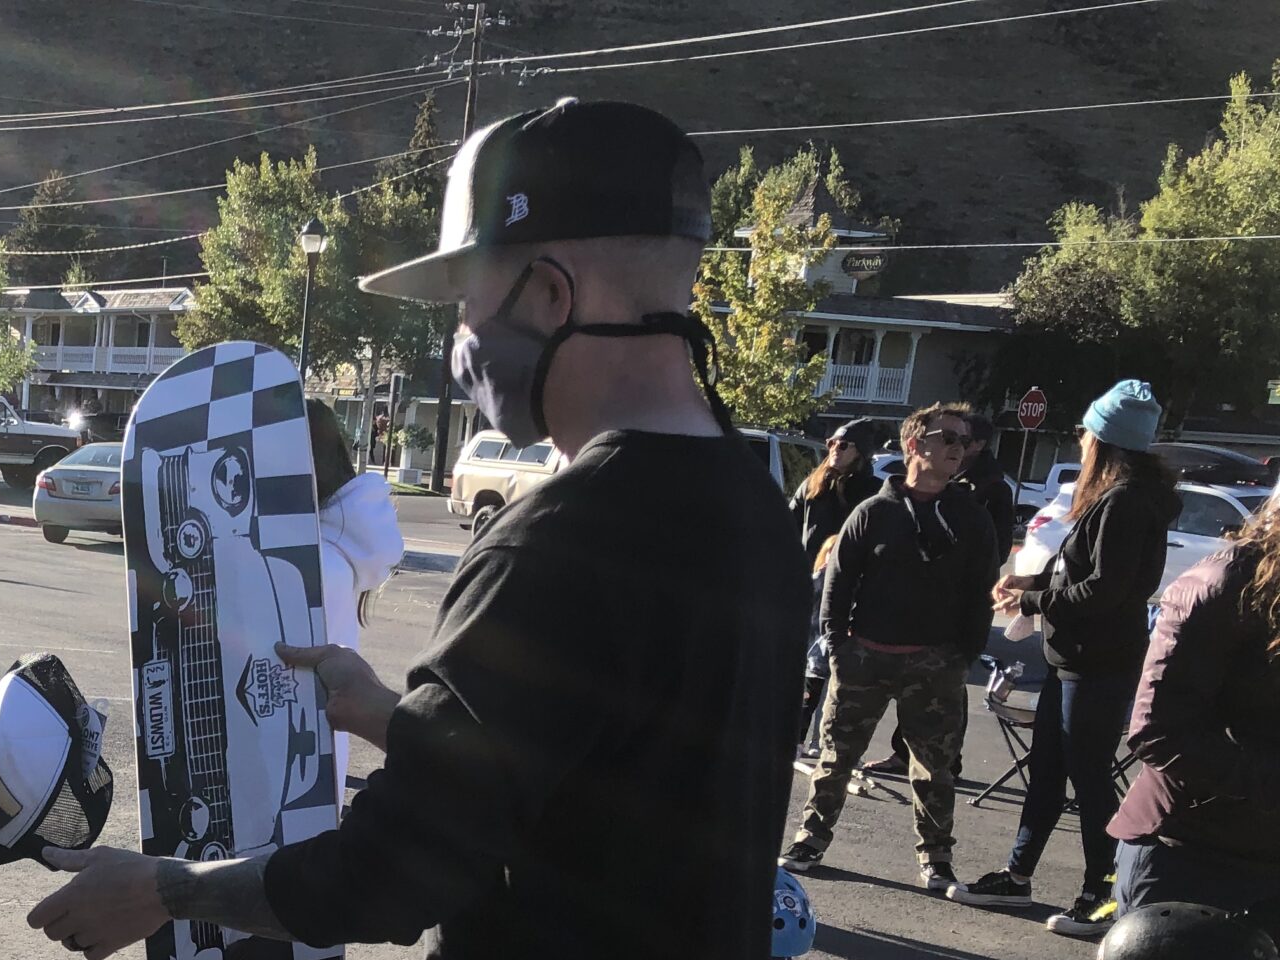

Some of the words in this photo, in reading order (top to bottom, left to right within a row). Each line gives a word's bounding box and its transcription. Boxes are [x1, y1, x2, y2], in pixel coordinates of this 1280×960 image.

[1020, 402, 1045, 417] STOP
[255, 662, 271, 716] HOFF'S
[148, 691, 166, 752] WLDWST
